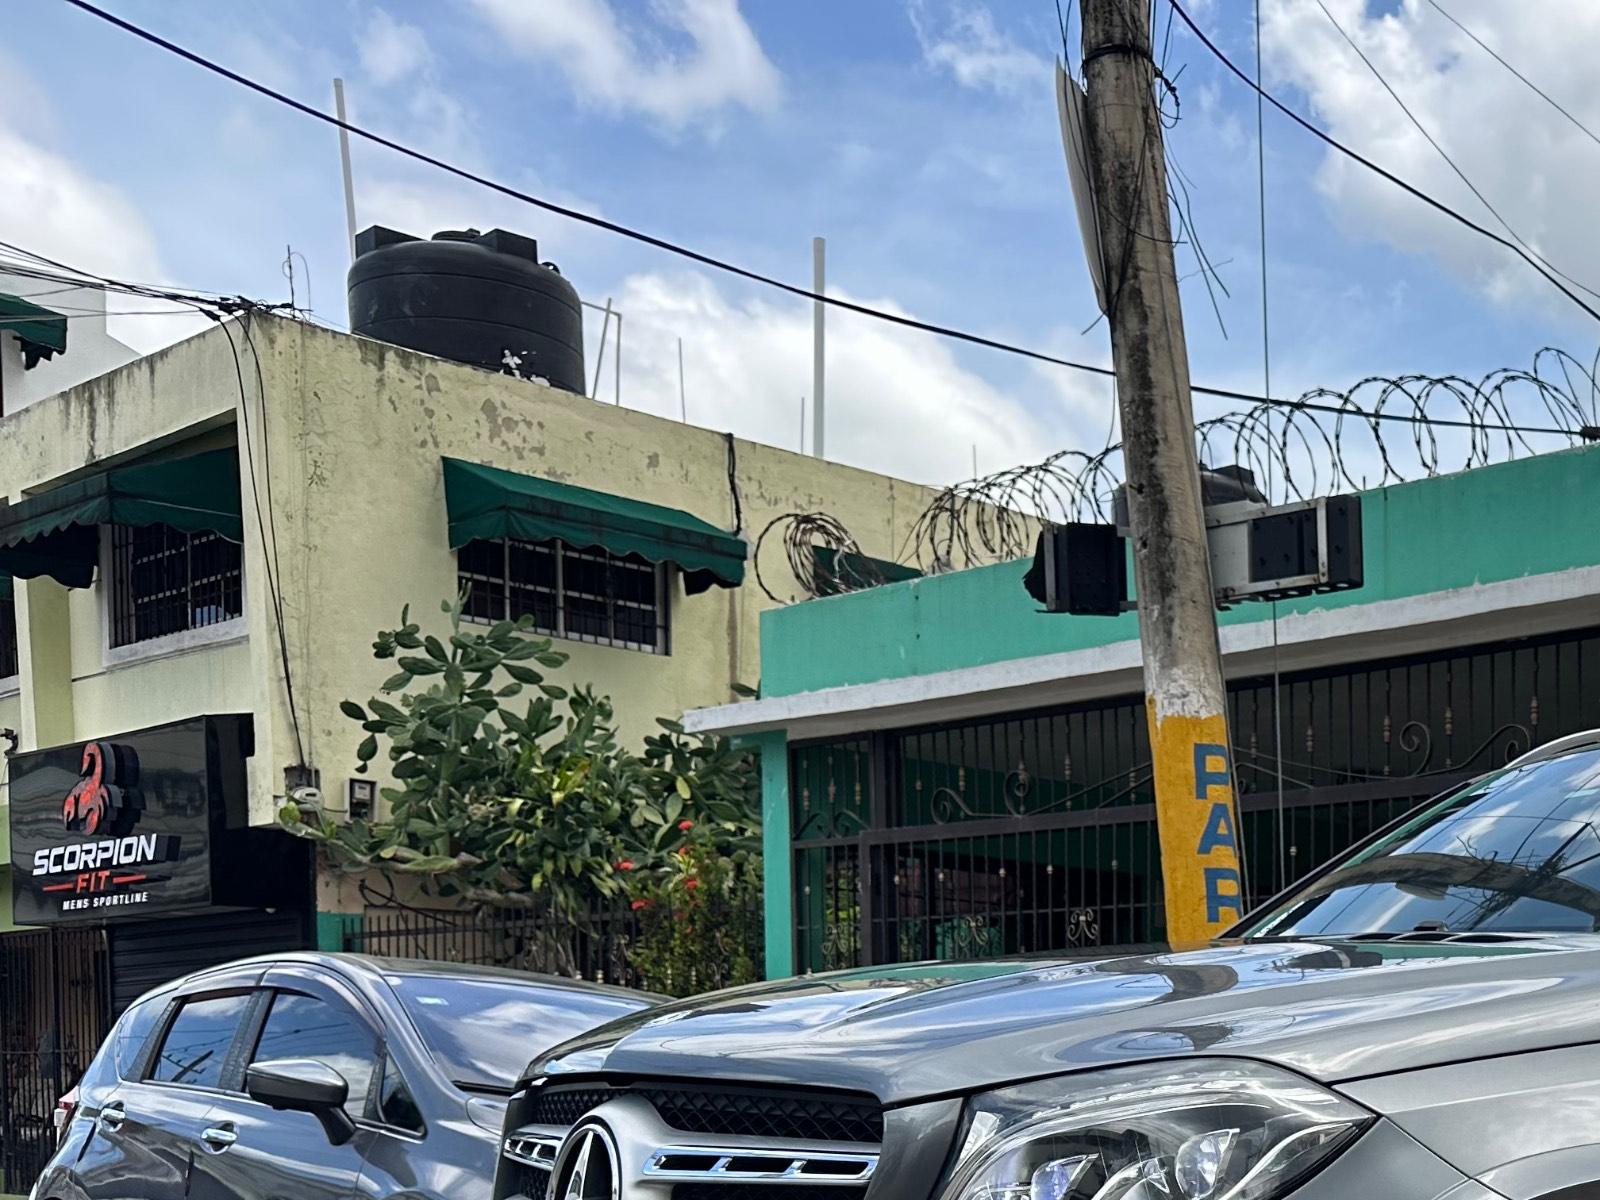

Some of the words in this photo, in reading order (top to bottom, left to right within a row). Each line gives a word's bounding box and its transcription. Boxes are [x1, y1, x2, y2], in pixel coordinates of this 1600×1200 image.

[32, 833, 157, 876] SCORPION
[76, 870, 111, 894] FIT
[62, 898, 90, 911] MENS
[93, 891, 149, 908] SPORTLINE
